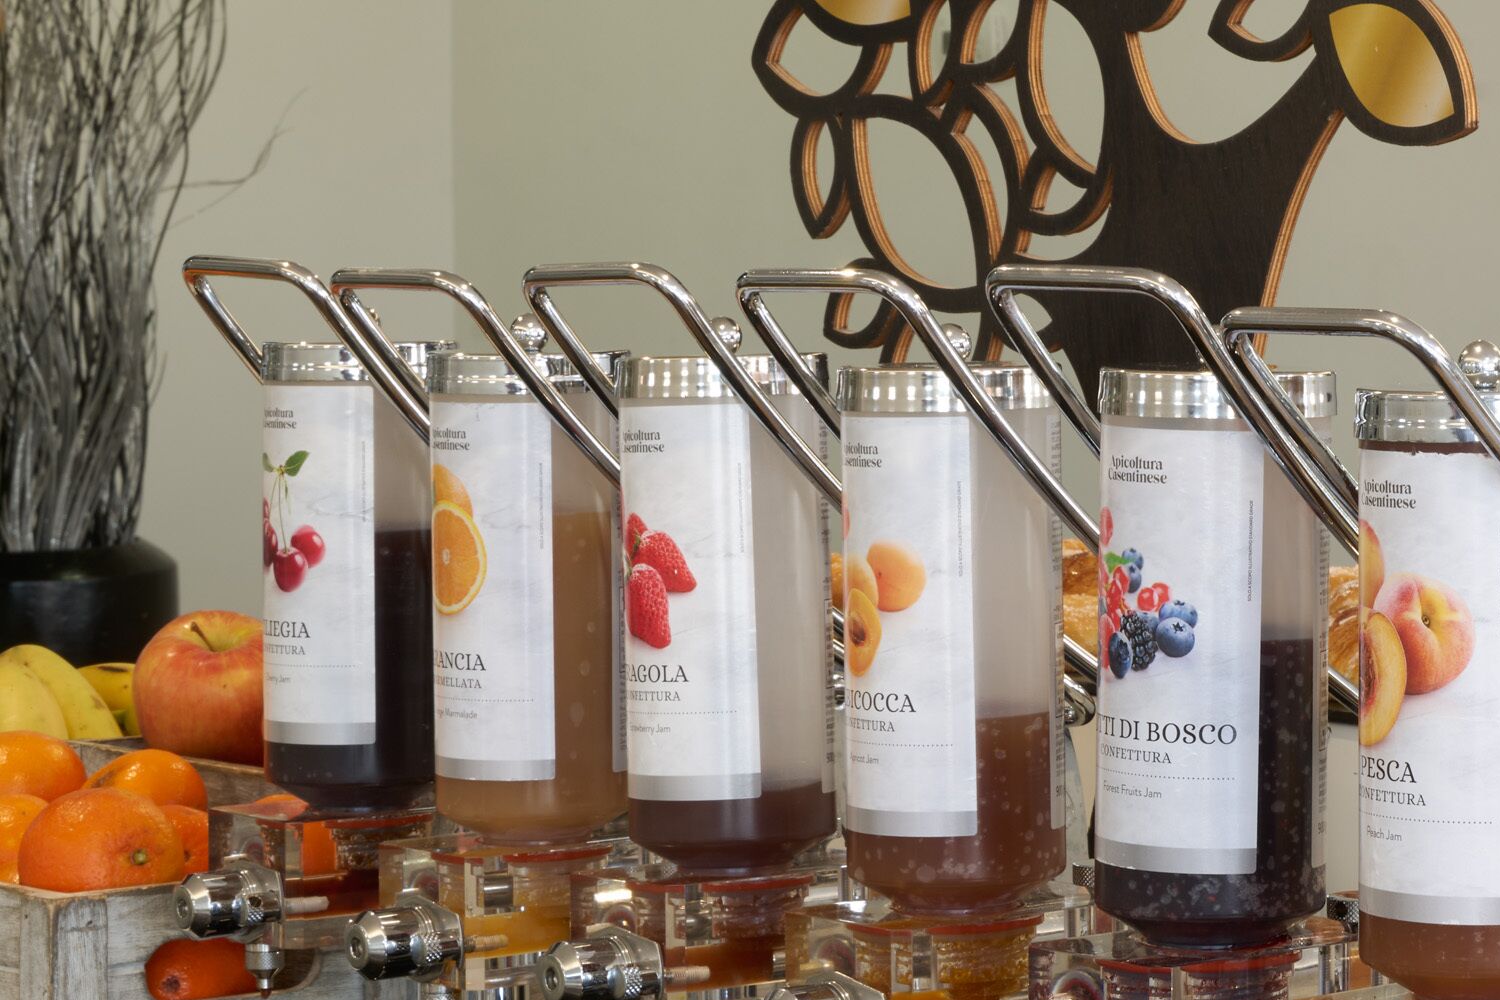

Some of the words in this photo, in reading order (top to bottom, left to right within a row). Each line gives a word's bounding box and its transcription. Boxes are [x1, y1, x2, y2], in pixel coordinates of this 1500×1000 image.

[1108, 467, 1168, 484] Casentinese
[1361, 493, 1417, 509] Casentinese
[263, 619, 311, 638] LIEGIA
[1119, 718, 1140, 741] DI
[1146, 722, 1237, 745] BOSCO
[1360, 755, 1417, 784] PESCA
[1121, 784, 1142, 797] Fruits
[1143, 787, 1162, 799] Jam
[1367, 825, 1385, 840] Peach
[1385, 829, 1403, 842] Jam
